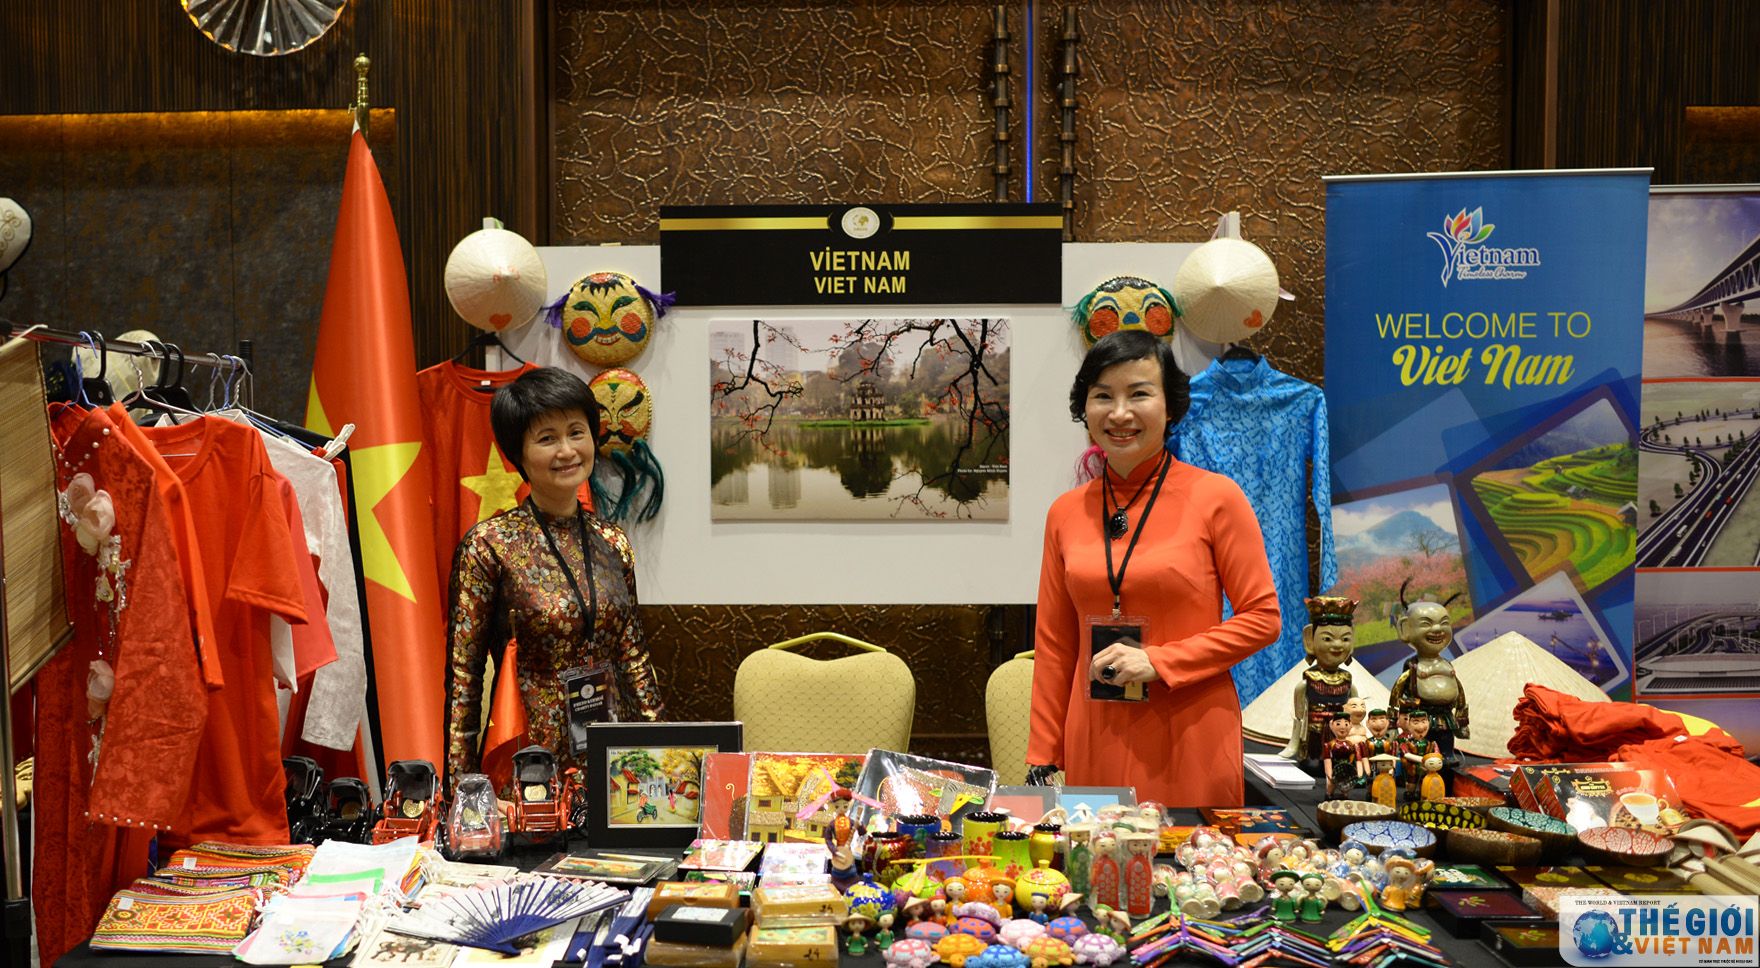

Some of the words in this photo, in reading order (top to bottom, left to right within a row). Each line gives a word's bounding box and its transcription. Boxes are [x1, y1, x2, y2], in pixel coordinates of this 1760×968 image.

[1426, 232, 1541, 288] Vietnam
[814, 276, 857, 294] VIET
[864, 276, 906, 294] NAM
[1375, 312, 1537, 339] WELCOME
[1547, 311, 1592, 338] TO
[1392, 344, 1472, 387] Viet
[1480, 343, 1575, 390] Nam
